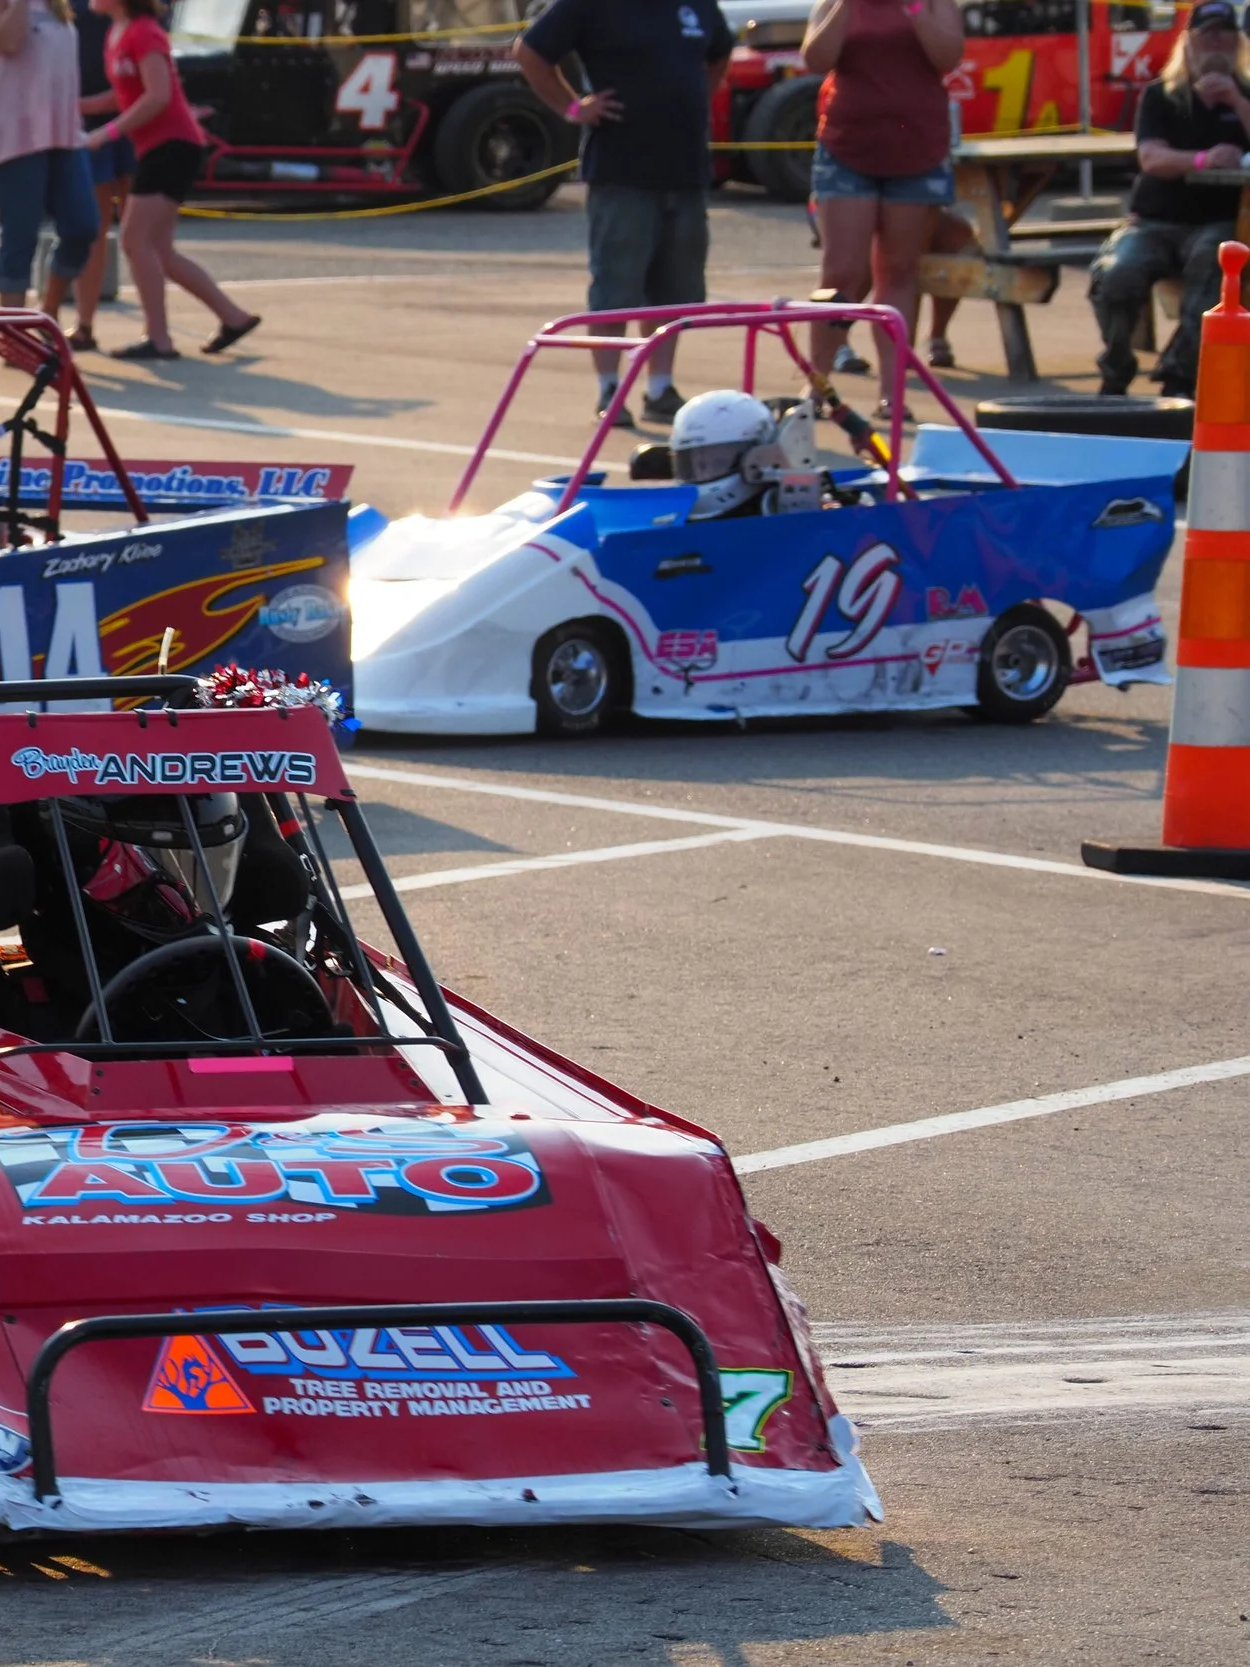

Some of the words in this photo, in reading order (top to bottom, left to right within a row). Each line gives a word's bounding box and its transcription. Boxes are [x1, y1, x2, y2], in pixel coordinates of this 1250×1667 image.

[337, 51, 401, 131] 4
[256, 466, 332, 498] LLC
[43, 551, 116, 578] Zachary
[786, 540, 901, 664] 19
[11, 746, 100, 784] Brayden
[95, 751, 316, 785] ANDREWS
[21, 1156, 541, 1207] AUTO
[21, 1212, 233, 1226] KALAMAZOO
[245, 1211, 338, 1224] SHOP
[263, 1396, 400, 1417] PROPERTY
[408, 1394, 592, 1416] MANAGEMENT
[290, 1377, 357, 1398] TREE
[365, 1379, 487, 1399] REMOVAL
[495, 1380, 551, 1396] AND
[699, 1367, 794, 1453] 7
